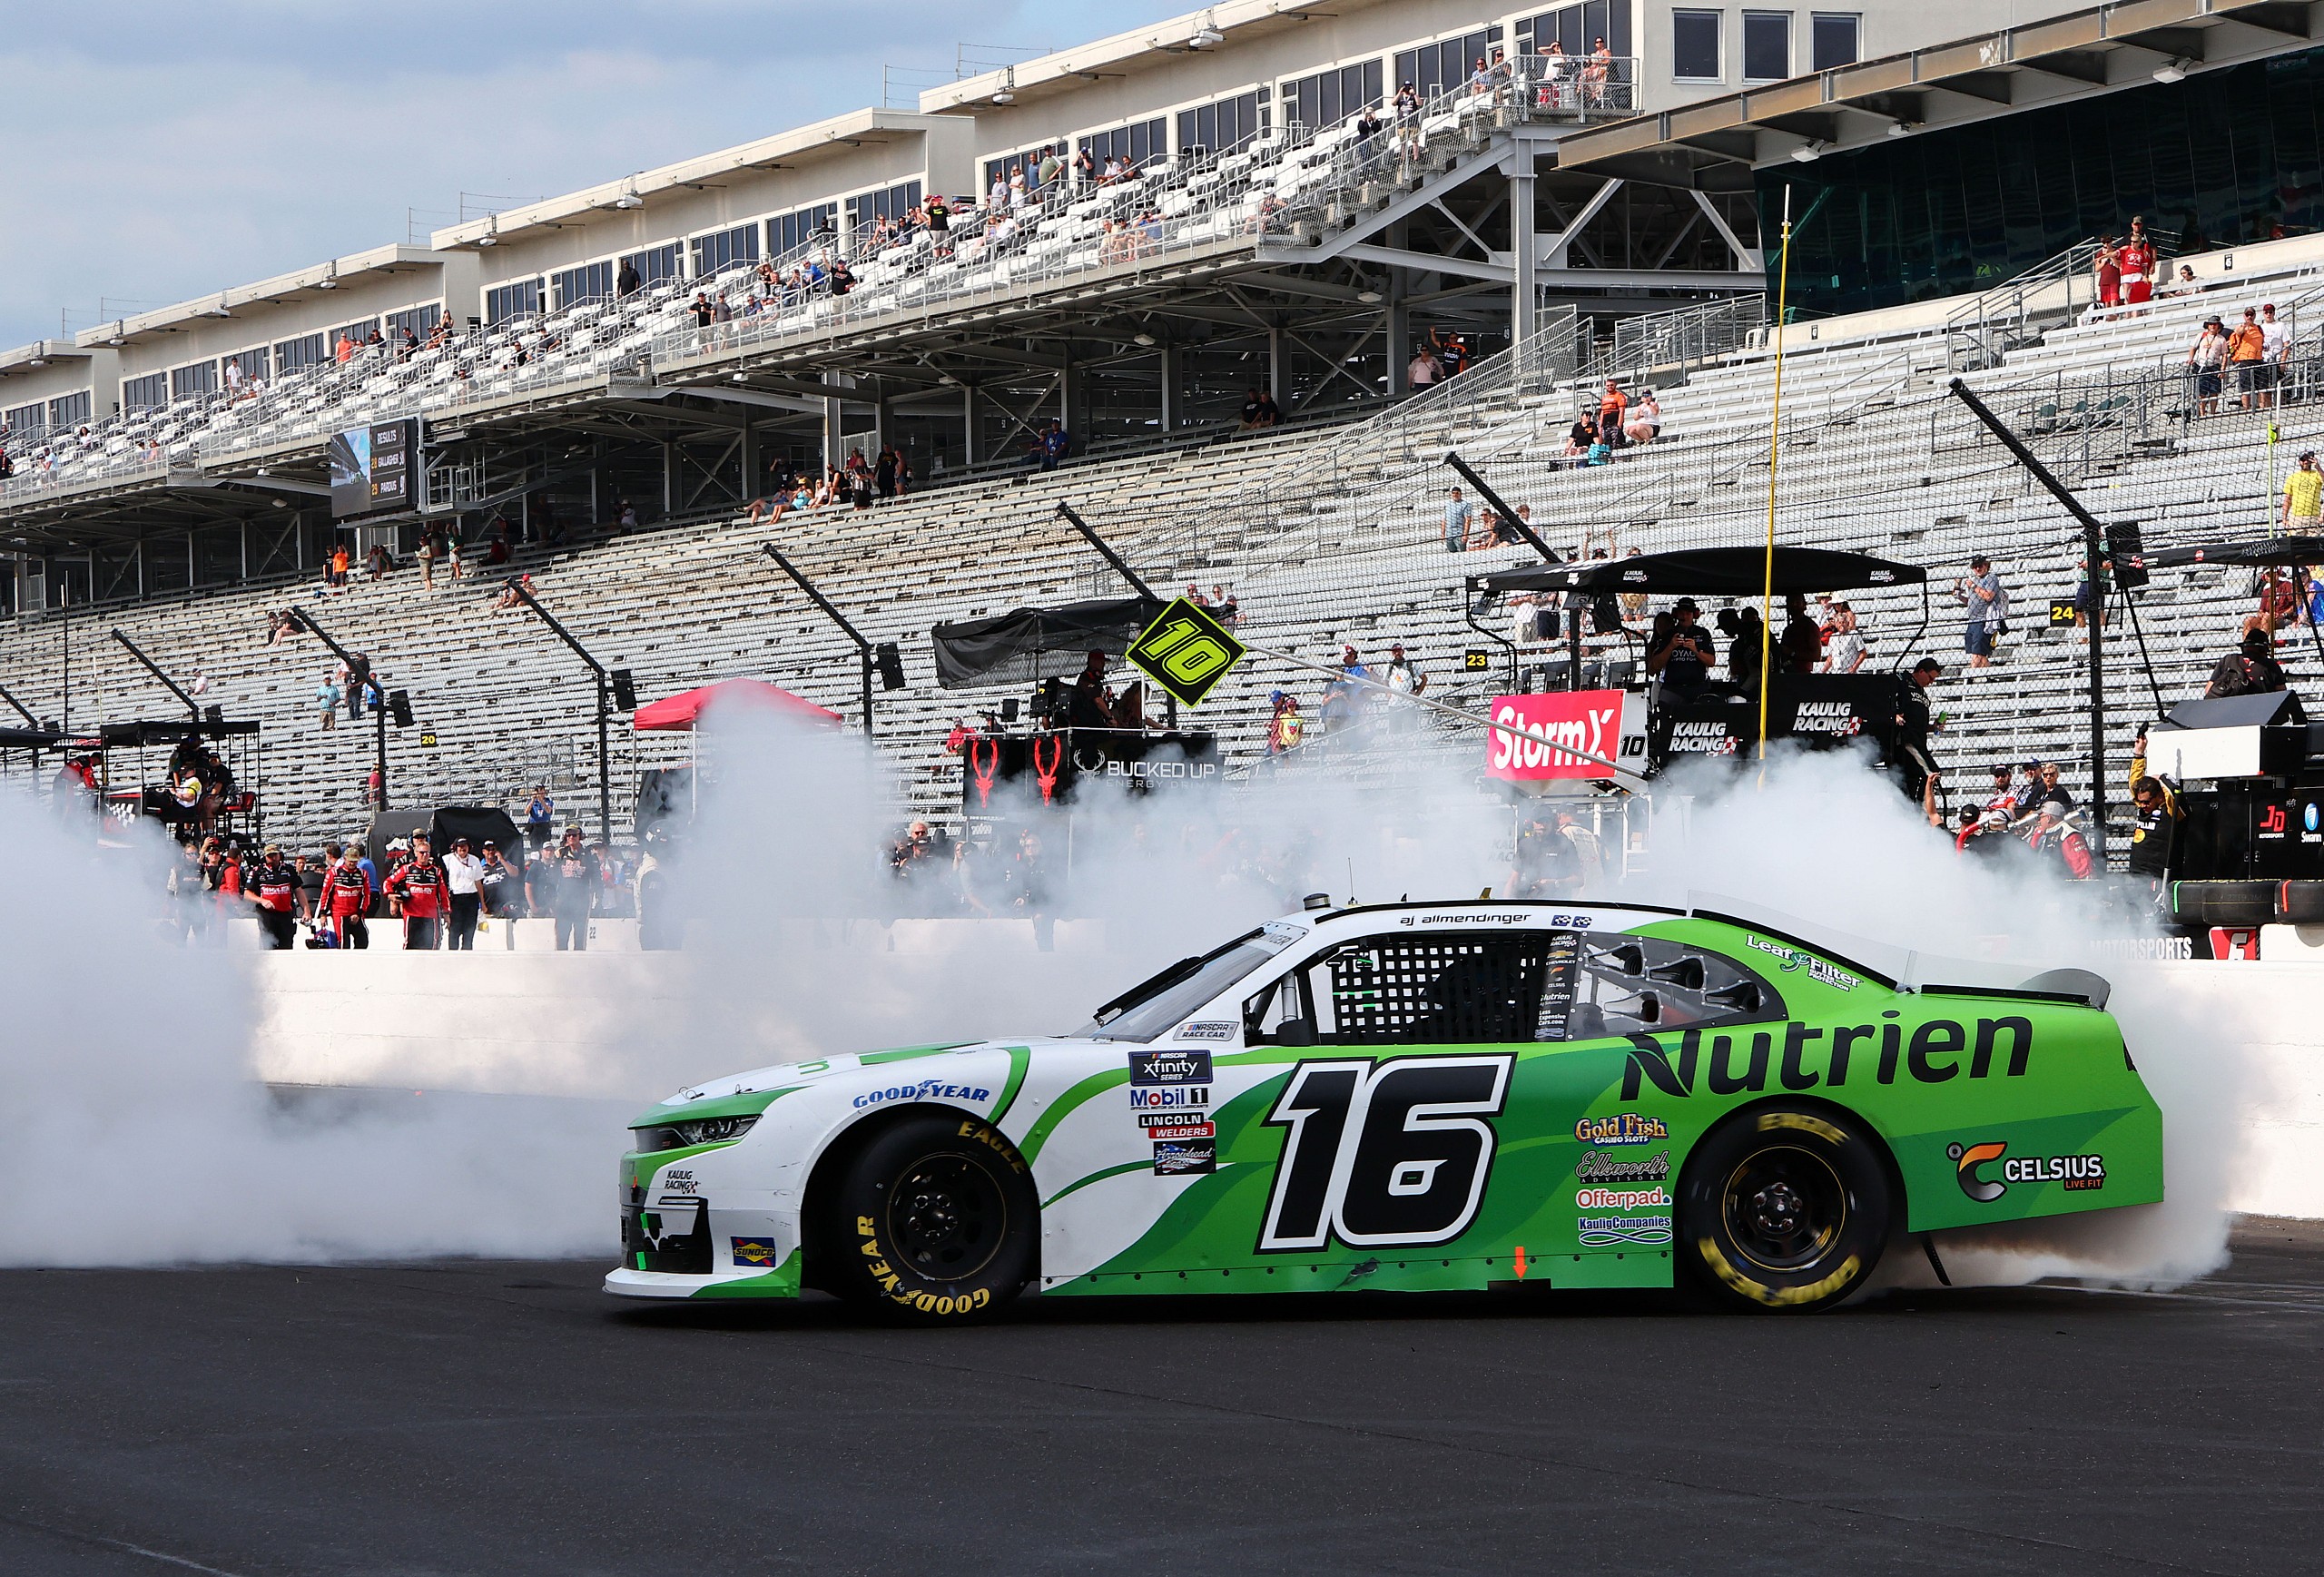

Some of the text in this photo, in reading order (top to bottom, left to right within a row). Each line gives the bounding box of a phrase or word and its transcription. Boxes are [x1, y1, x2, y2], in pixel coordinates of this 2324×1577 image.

[377, 429, 397, 445] RESULTS
[380, 480, 397, 494] PARDUS
[2052, 606, 2074, 620] 24
[1138, 618, 1230, 685] 10
[1467, 655, 1486, 666] 23
[1797, 703, 1851, 716] KAULIG
[1673, 723, 1726, 736] KAULIG
[1793, 717, 1849, 731] RACING
[421, 735, 435, 744] 20
[1493, 705, 1615, 770] StormX
[1669, 737, 1723, 752] RACING
[1620, 734, 1648, 758] 10
[1108, 761, 1216, 779] BUCKED UP
[1106, 780, 1163, 788] ENERGY
[2301, 831, 2322, 843] Swann
[1400, 914, 1531, 926] aj allmendinger
[2090, 937, 2192, 961] MOTORSPORTS
[1746, 934, 1862, 988] Leaf Filter
[1808, 972, 1850, 991] PROTECTION
[1541, 992, 1571, 1001] Nutrien
[1620, 1010, 2033, 1101] Nutrien
[1144, 1060, 1197, 1077] xfinity
[1130, 1089, 1206, 1106] Mobil 1
[1141, 1115, 1201, 1127] LINCOLN
[1575, 1113, 1668, 1141] Gold Fish
[1156, 1128, 1208, 1138] WELDERS
[958, 1120, 1025, 1175] EAGLE
[1155, 1146, 1213, 1160] Arrowhead
[1255, 1052, 1517, 1254] 16
[1576, 1150, 1669, 1178] Ellsworth
[2004, 1157, 2102, 1181] CELSIUS
[667, 1170, 693, 1179] KAULIG
[1581, 1175, 1666, 1183] ADVISORS
[665, 1180, 690, 1189] RACING
[2065, 1179, 2102, 1188] LIVE FIT
[1578, 1188, 1662, 1209] Offerpad
[1580, 1217, 1670, 1229] KauligCompanies
[735, 1247, 773, 1257] SUNOCO
